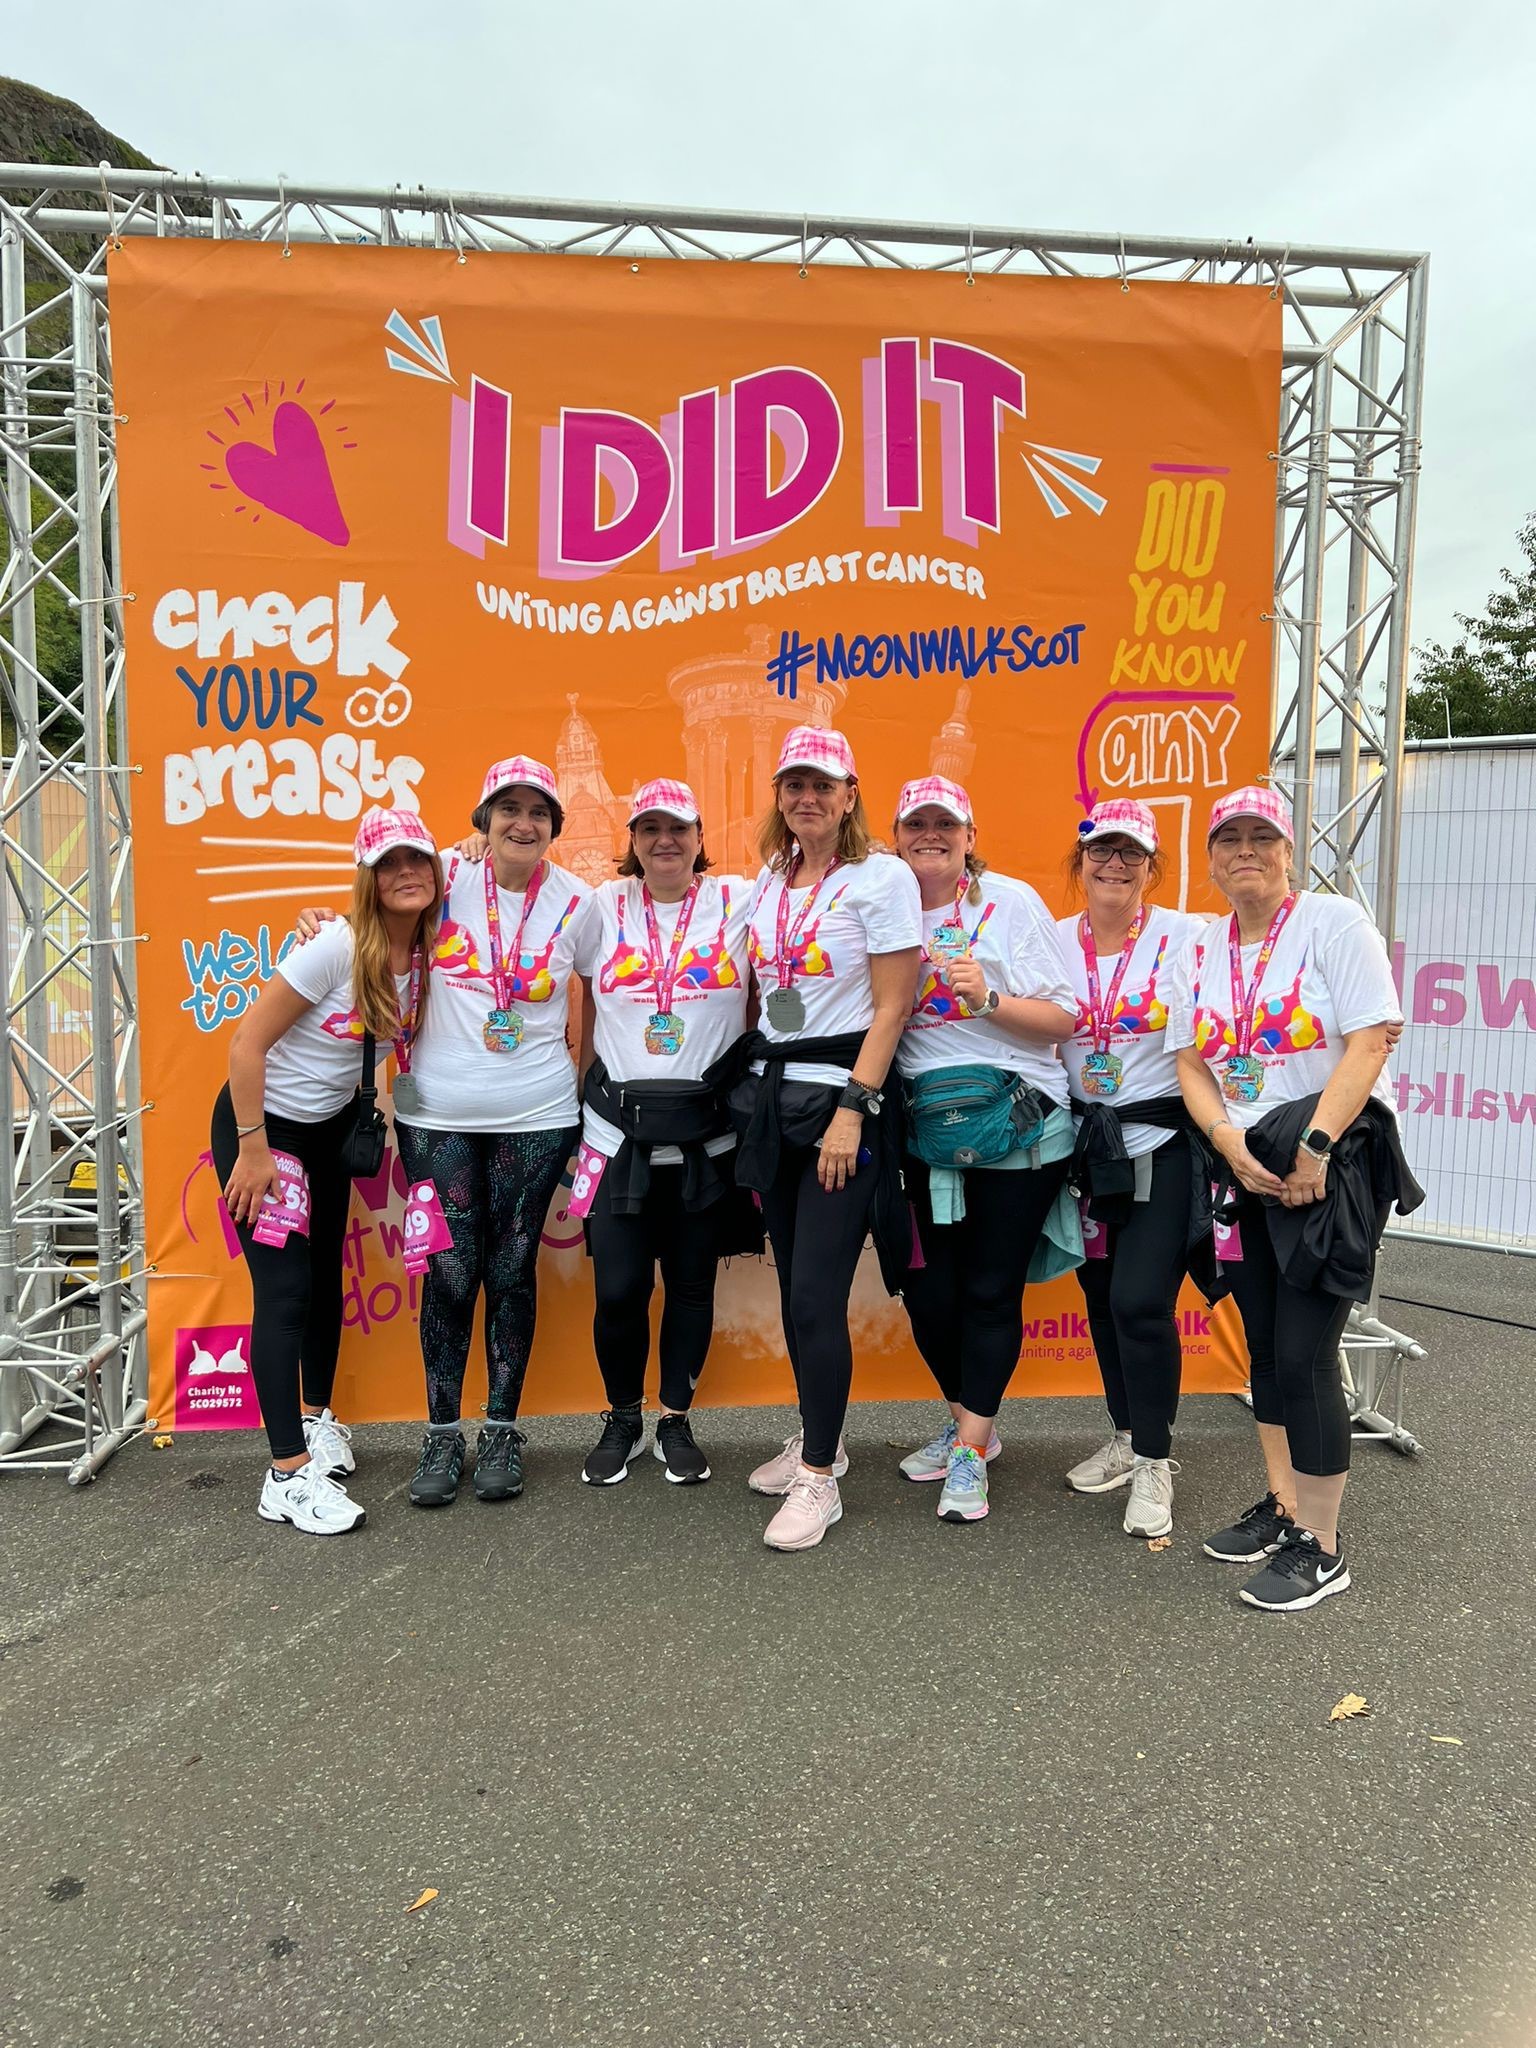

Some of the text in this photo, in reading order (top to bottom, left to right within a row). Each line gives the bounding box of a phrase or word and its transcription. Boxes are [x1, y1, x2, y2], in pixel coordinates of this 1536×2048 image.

[462, 337, 1026, 571] I DID IT
[1135, 478, 1226, 578] DID
[746, 550, 862, 605] BREAST
[866, 551, 987, 600] CANCER
[1109, 639, 1247, 687] KNOW
[175, 664, 325, 733] YOUR
[188, 1385, 242, 1397] Charity No
